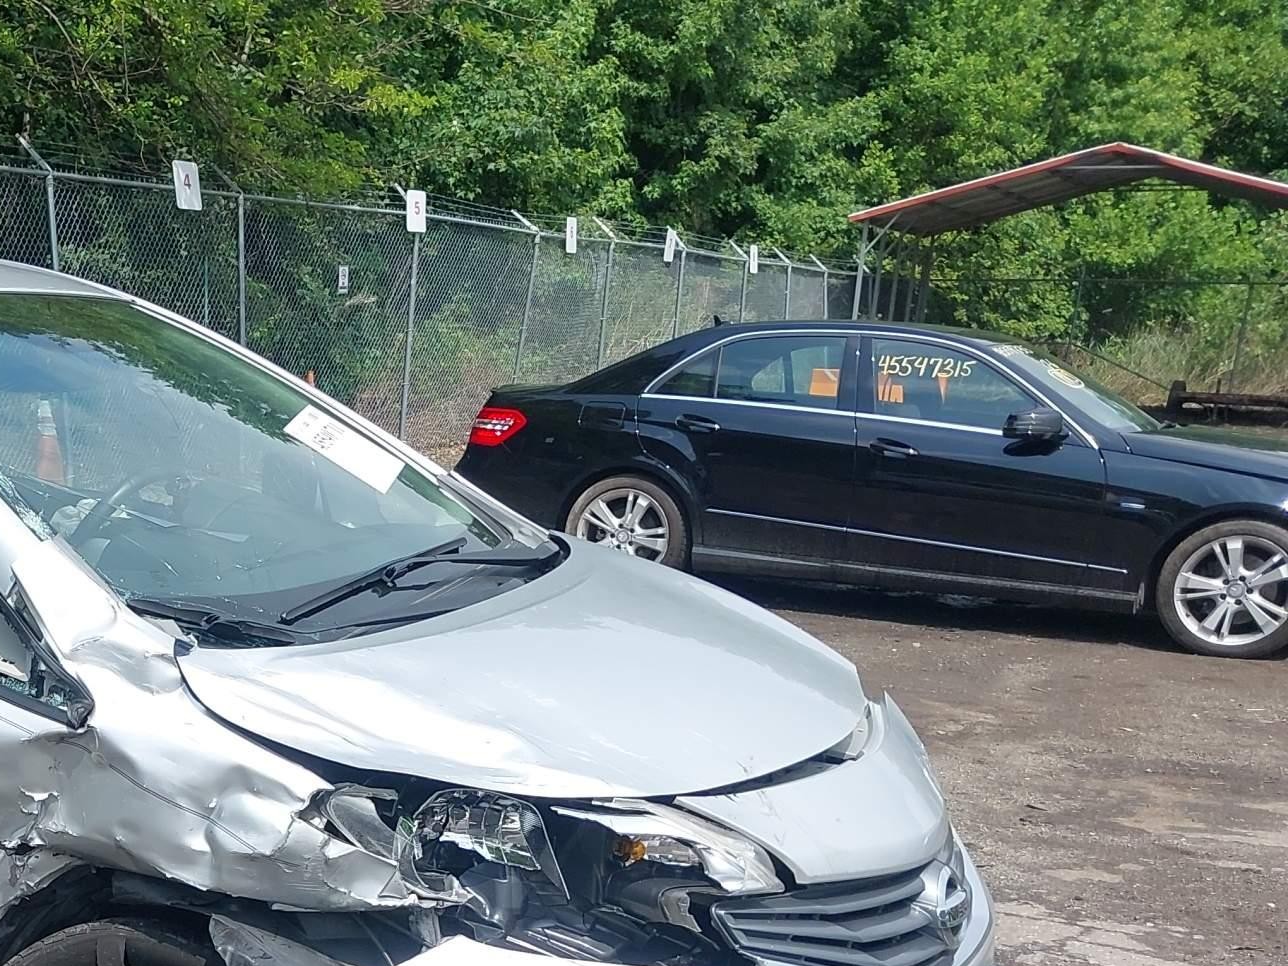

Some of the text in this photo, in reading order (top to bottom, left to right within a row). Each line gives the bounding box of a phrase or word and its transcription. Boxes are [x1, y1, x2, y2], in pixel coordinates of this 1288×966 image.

[183, 173, 192, 190] 4
[414, 201, 421, 216] 5
[878, 354, 977, 379] 45547315
